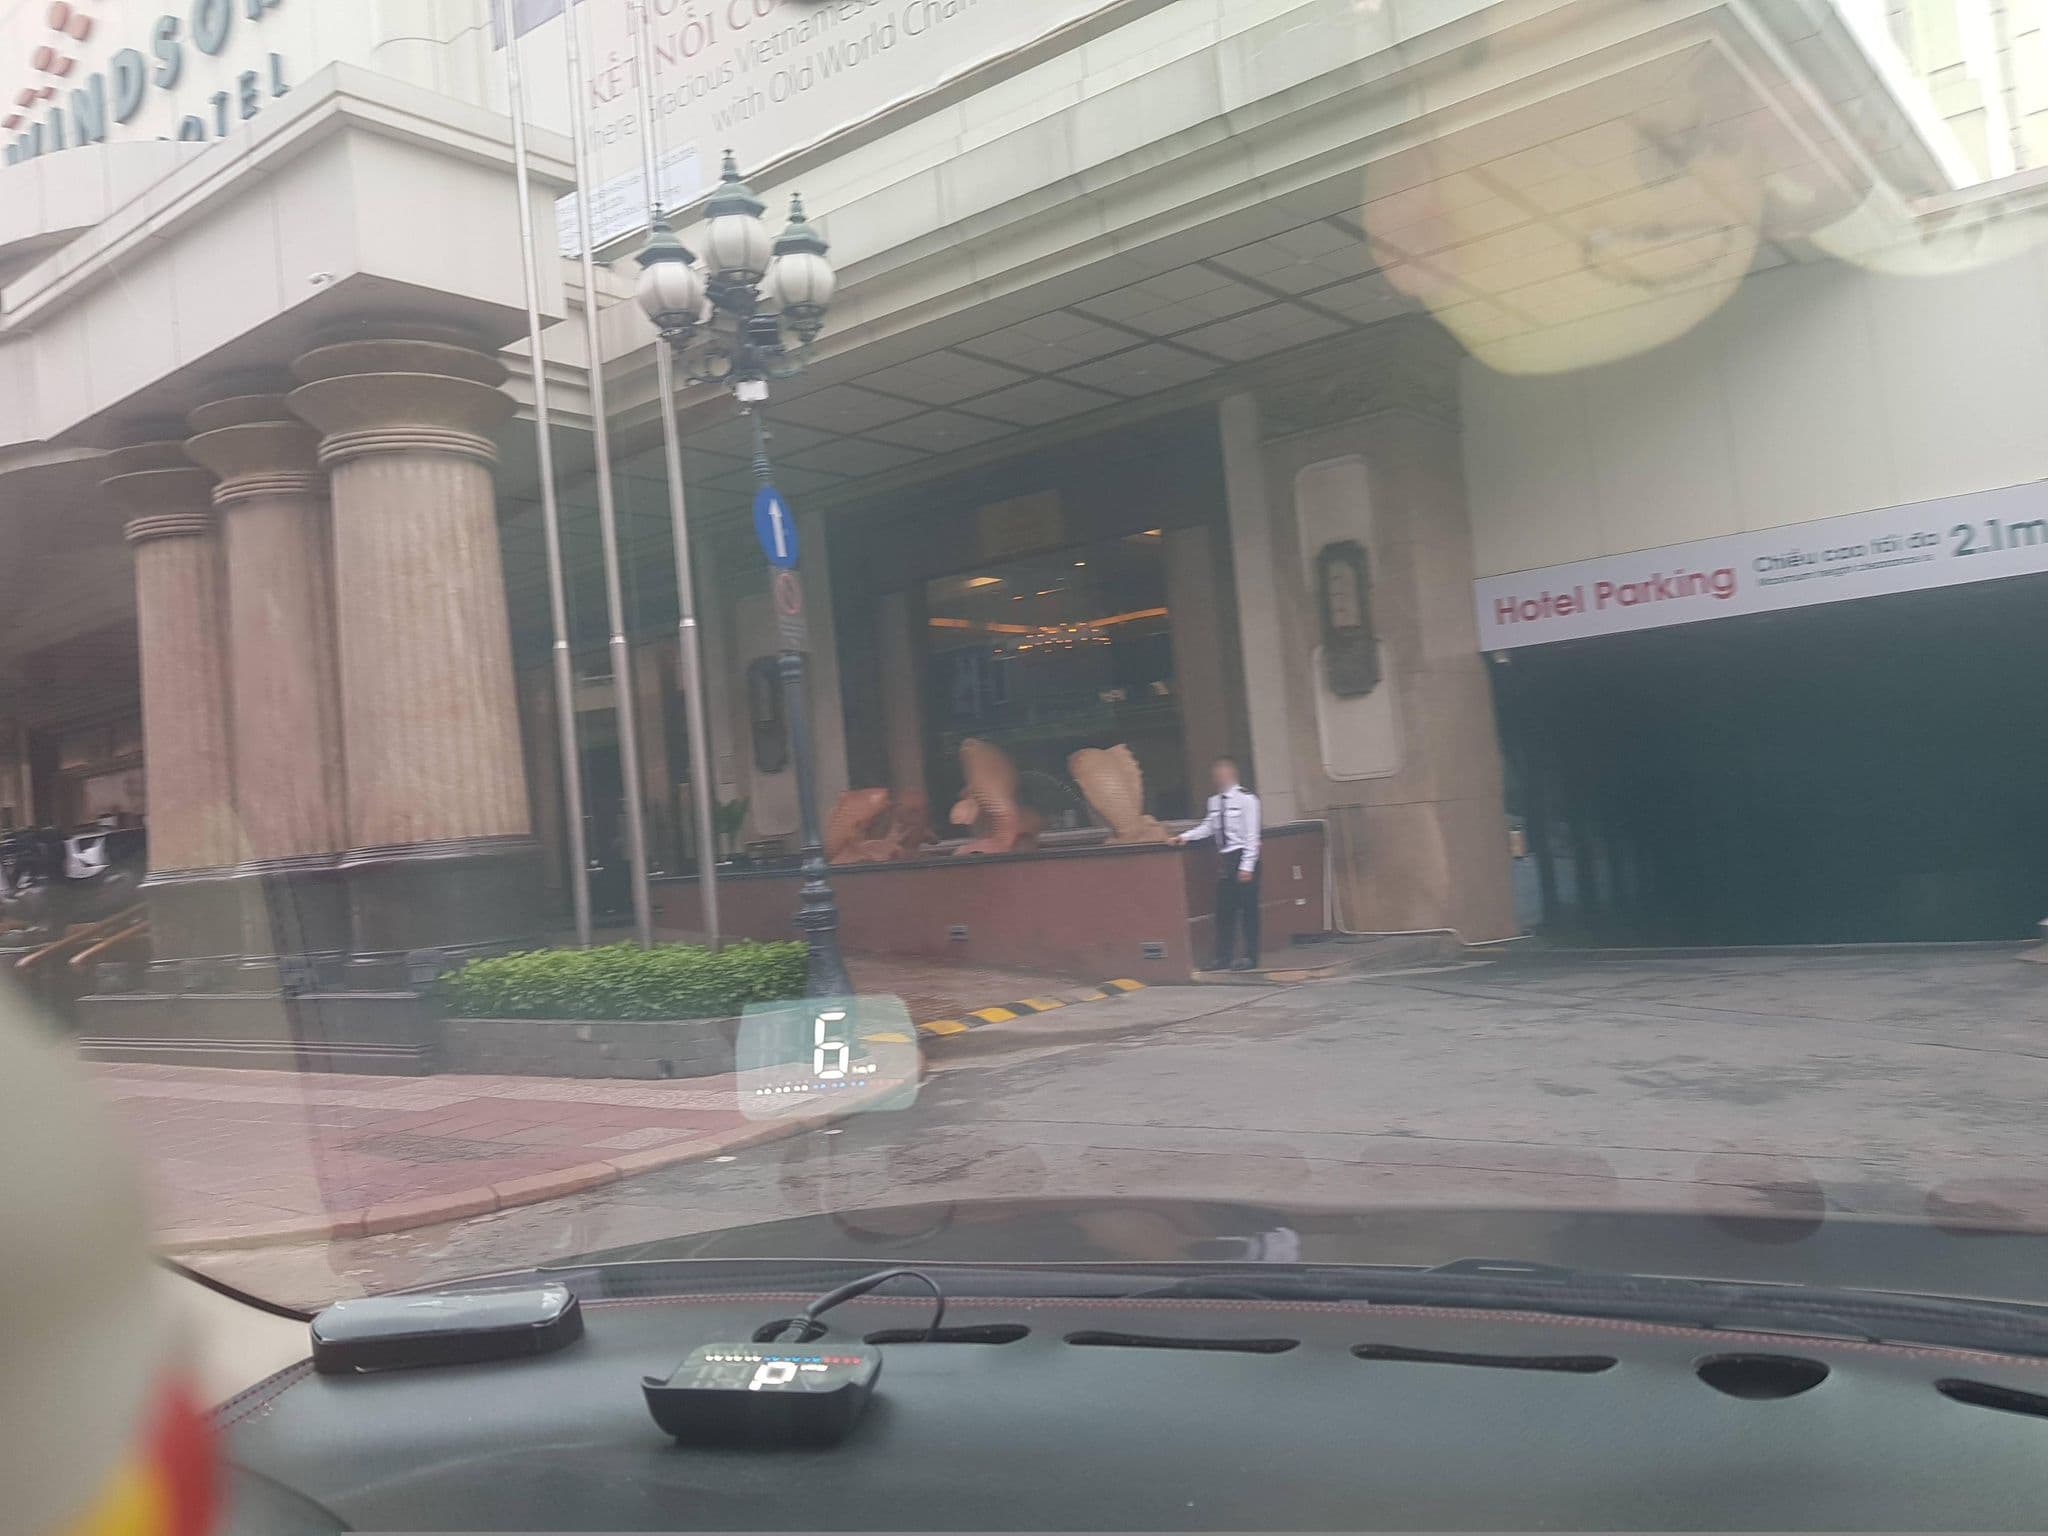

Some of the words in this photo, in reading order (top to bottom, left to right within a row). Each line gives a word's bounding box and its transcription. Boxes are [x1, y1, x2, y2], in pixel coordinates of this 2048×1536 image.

[733, 0, 882, 72] Vietnames
[768, 54, 814, 103] Old
[816, 11, 897, 79] World
[156, 52, 291, 142] OTEL
[1493, 585, 1586, 625] Hotel
[1594, 567, 1737, 610] Parking
[813, 1011, 849, 1079] 6
